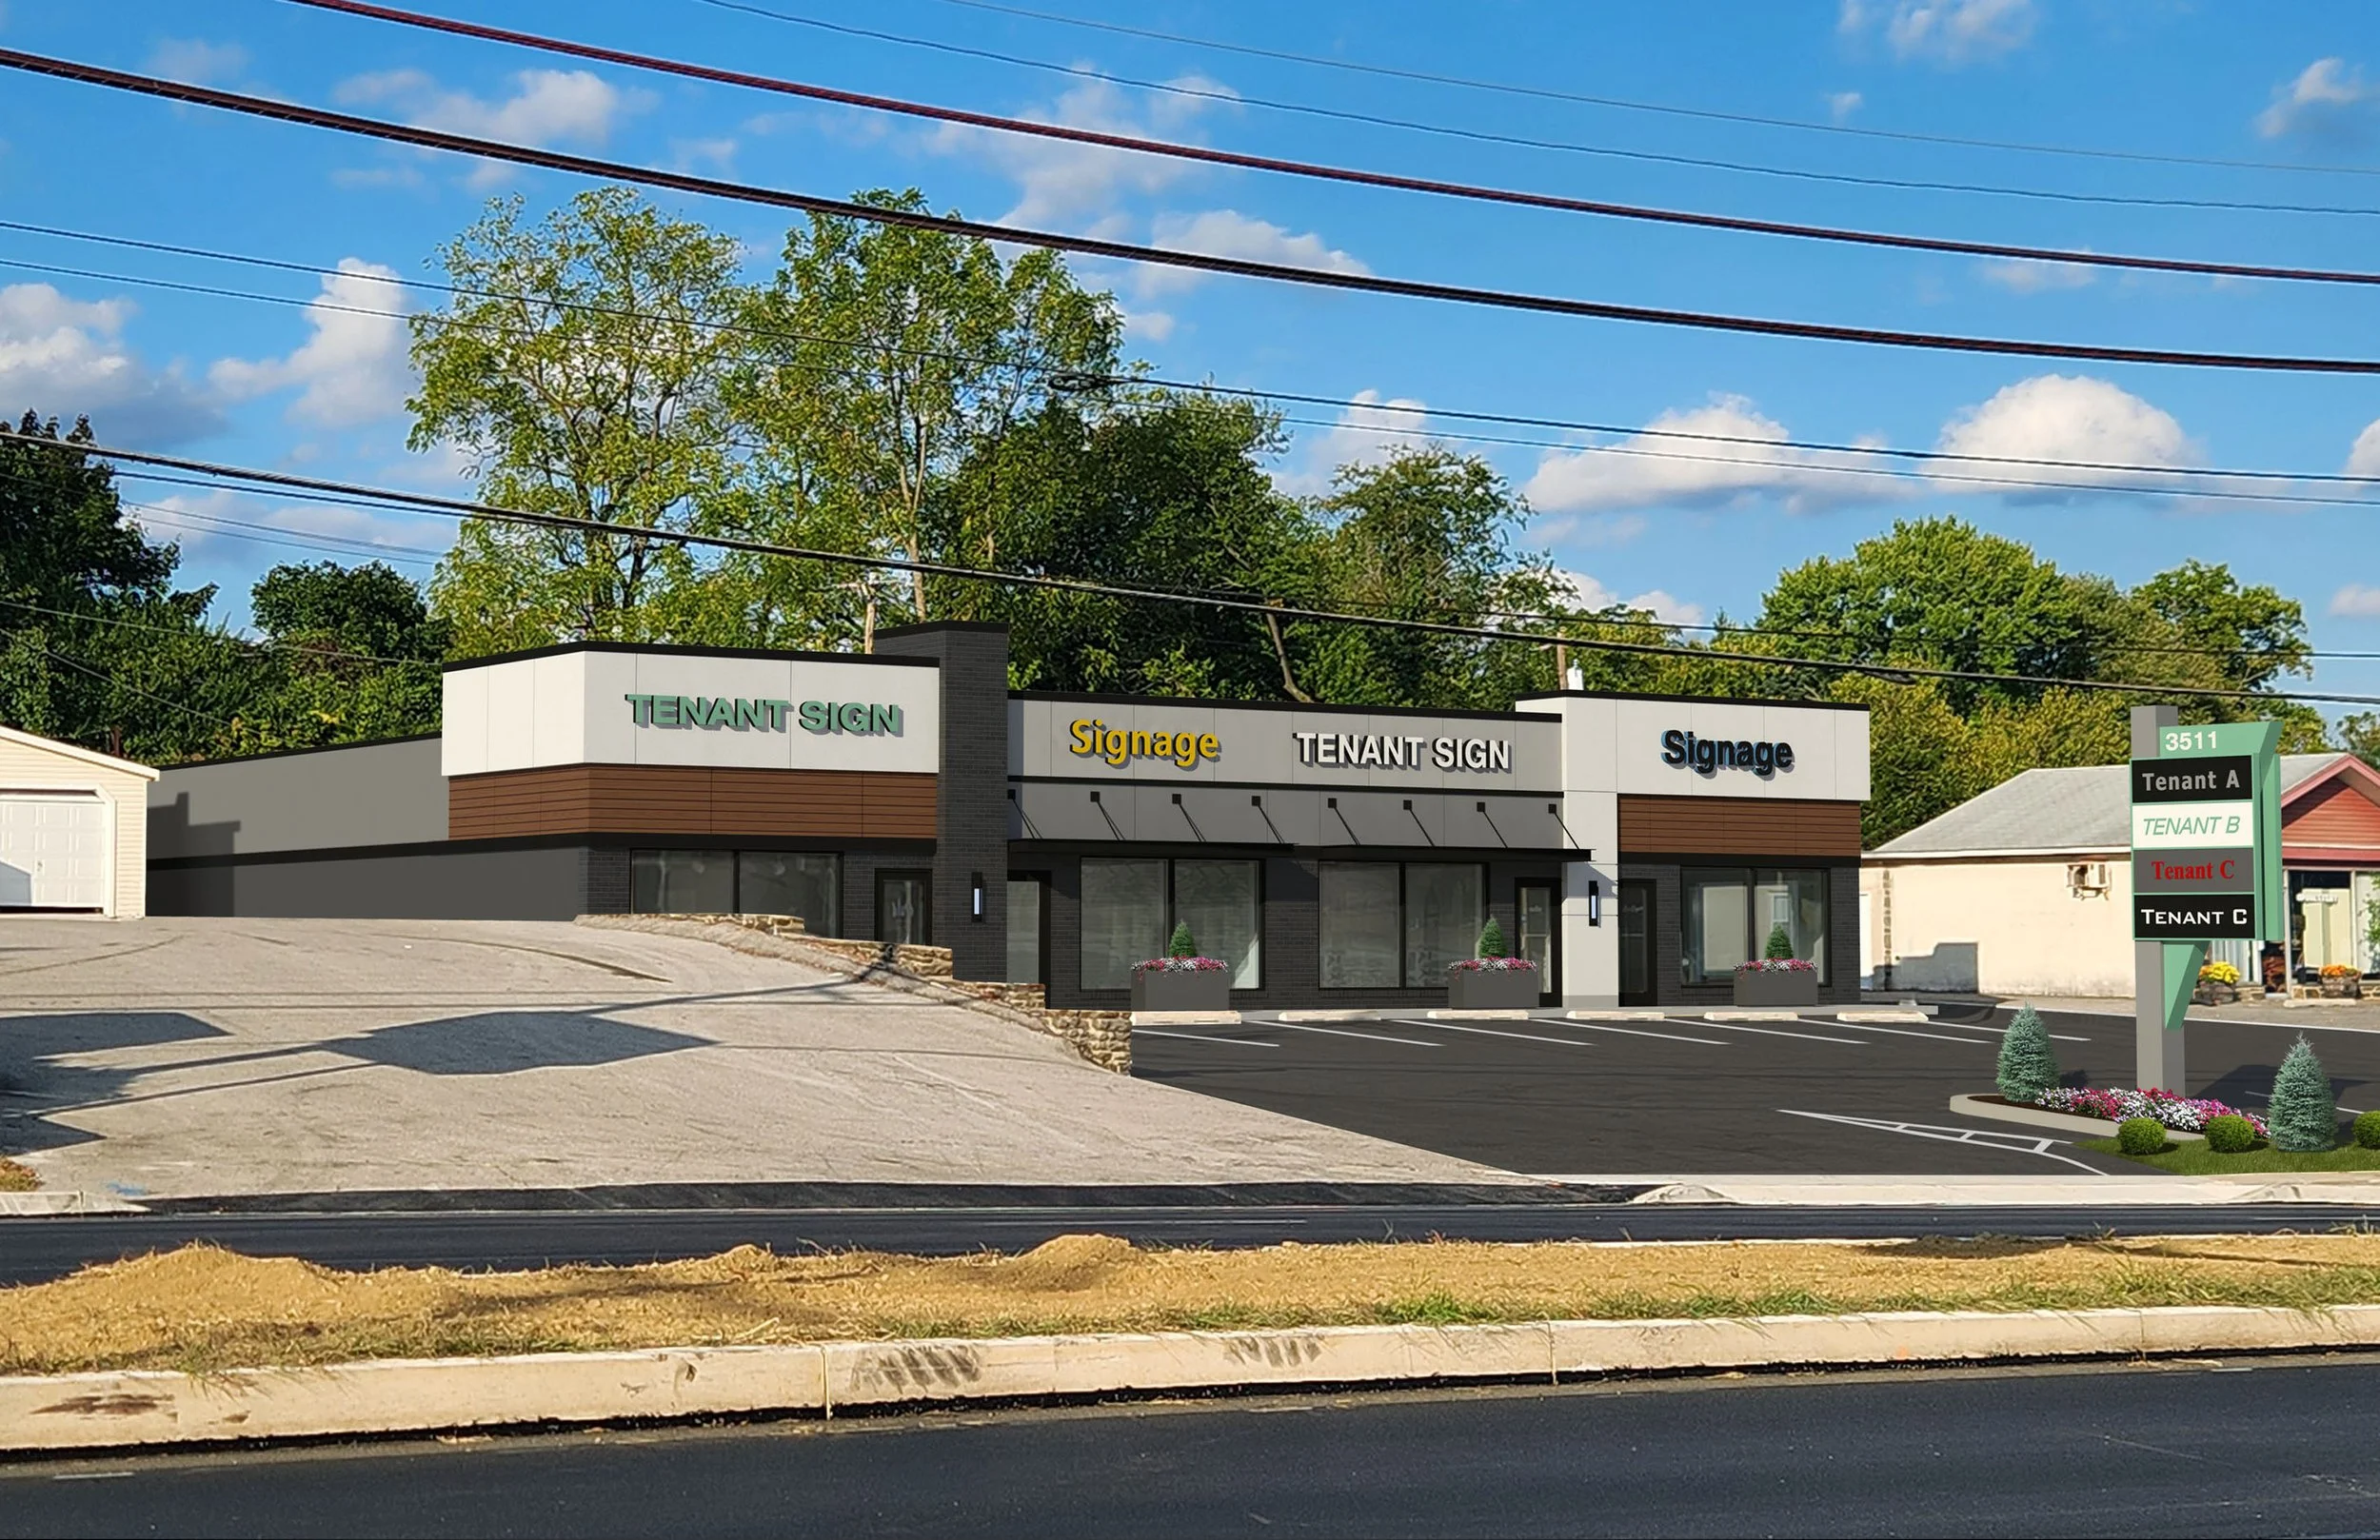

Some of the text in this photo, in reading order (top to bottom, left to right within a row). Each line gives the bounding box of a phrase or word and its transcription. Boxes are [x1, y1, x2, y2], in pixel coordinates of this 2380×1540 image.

[625, 694, 902, 735] TENANT SIGN
[1069, 719, 1220, 765] Signage
[1293, 731, 1512, 771] TENANT SIGN
[1662, 729, 1794, 775] Signage
[2165, 731, 2218, 751] 3511
[2142, 769, 2240, 792] Tenant A
[2143, 816, 2241, 836] TENANT B
[2151, 859, 2235, 880] Tenant C
[2140, 908, 2248, 925] TENANT C
